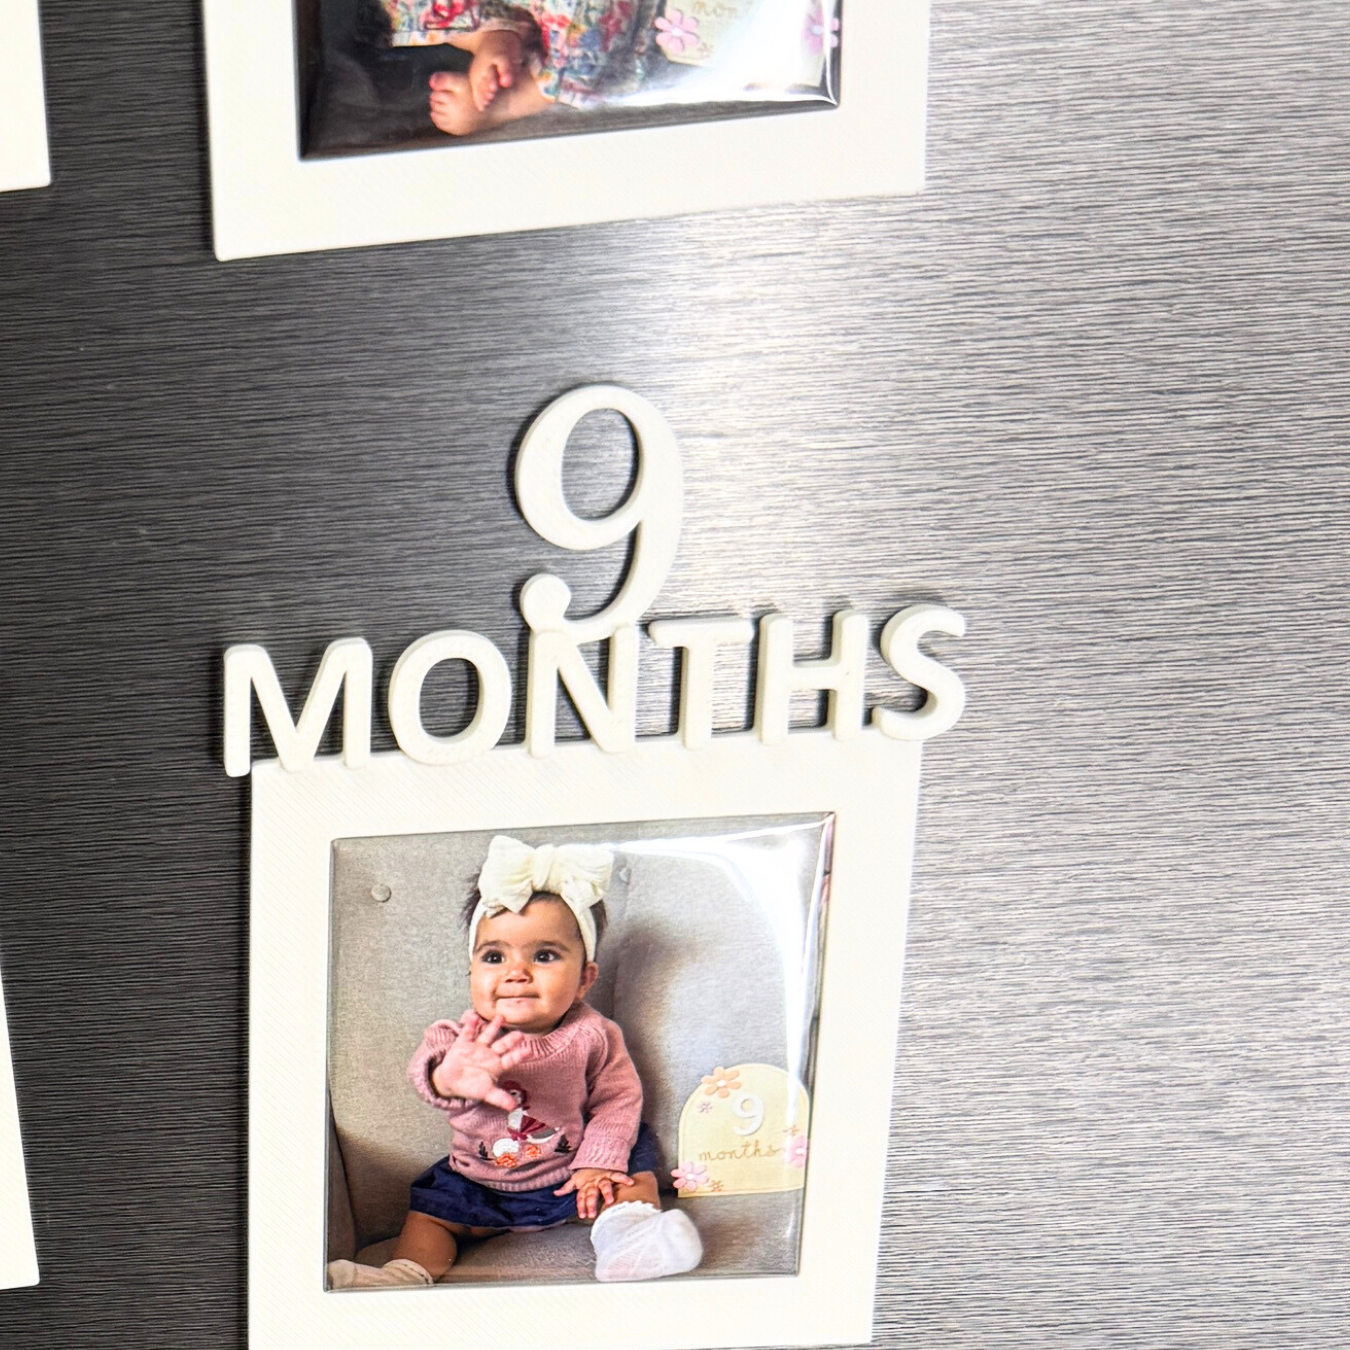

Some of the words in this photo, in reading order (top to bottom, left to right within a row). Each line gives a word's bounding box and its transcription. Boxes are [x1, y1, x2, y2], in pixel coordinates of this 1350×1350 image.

[515, 383, 682, 642] 9
[223, 603, 966, 778] MONTHS
[699, 1140, 781, 1161] months
[731, 1093, 765, 1137] 9
